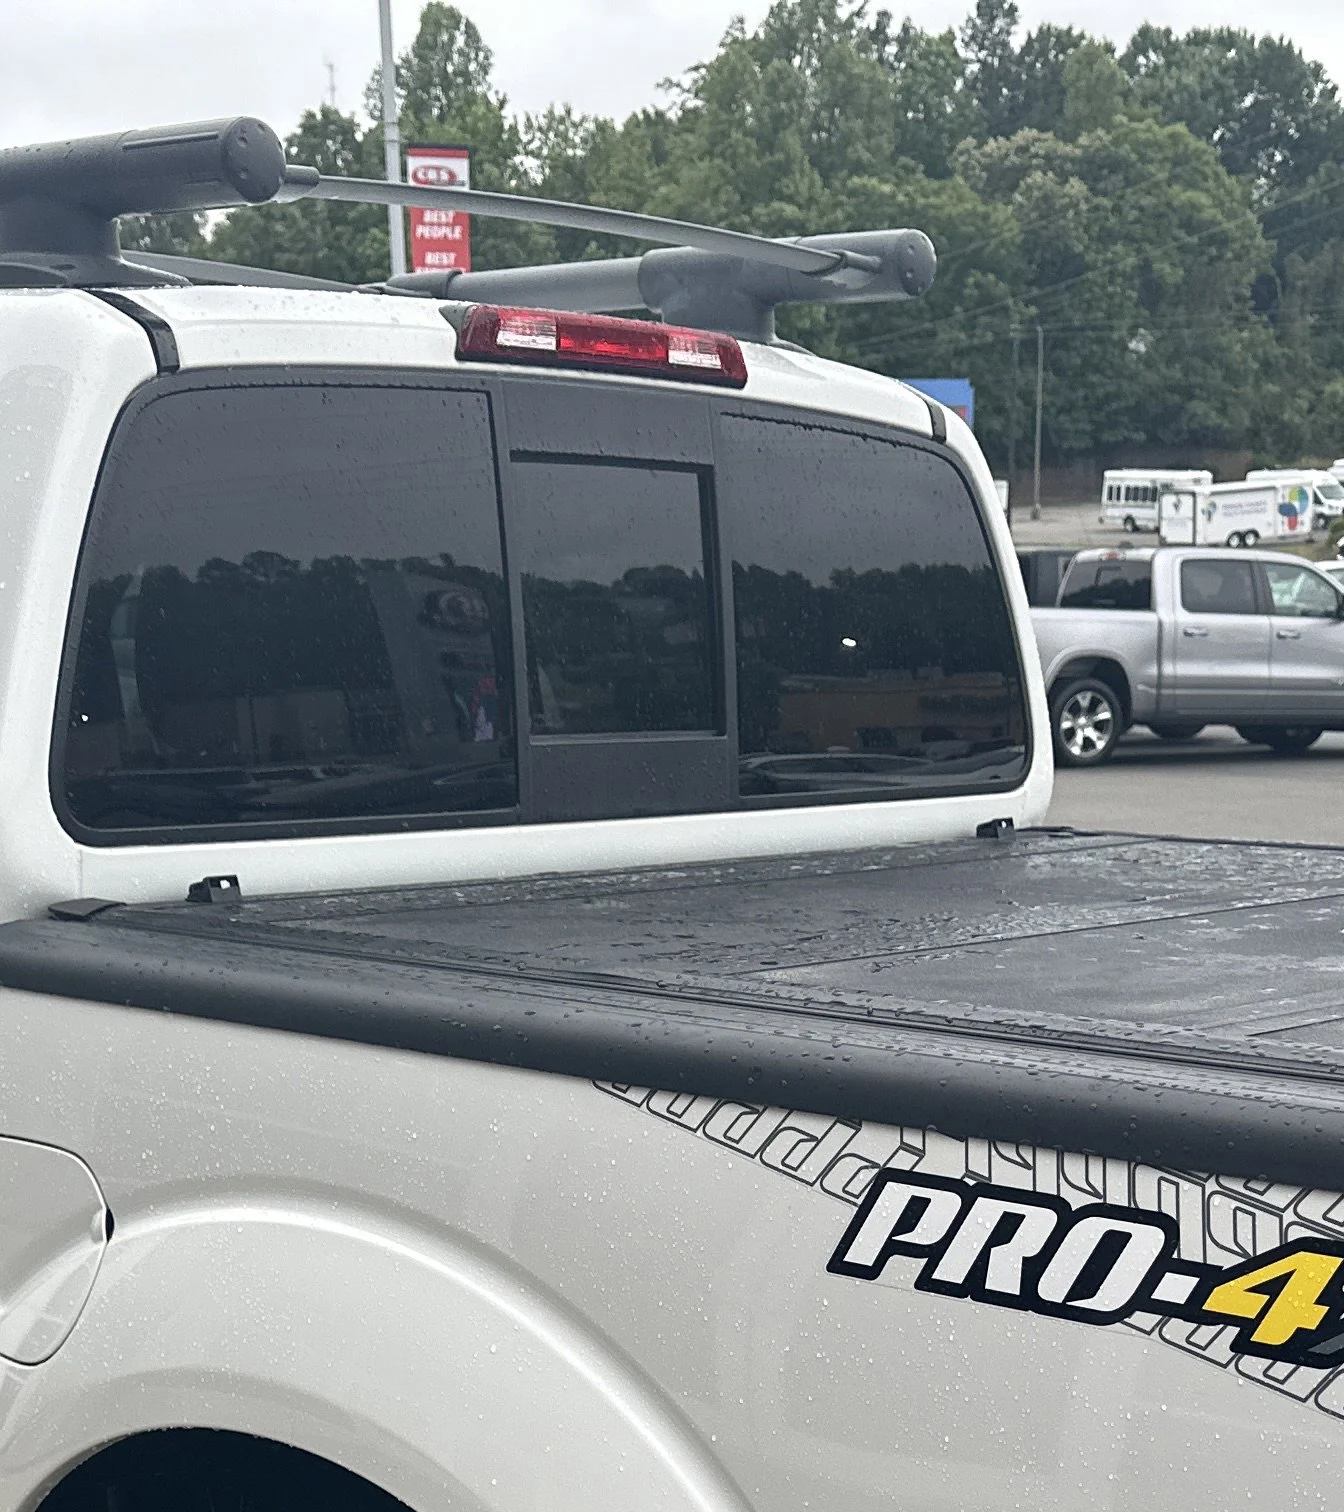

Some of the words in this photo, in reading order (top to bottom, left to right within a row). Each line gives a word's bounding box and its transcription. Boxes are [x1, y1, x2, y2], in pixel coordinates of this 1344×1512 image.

[423, 209, 455, 223] BEST
[415, 223, 463, 240] PEOPLE
[424, 251, 457, 265] BEST
